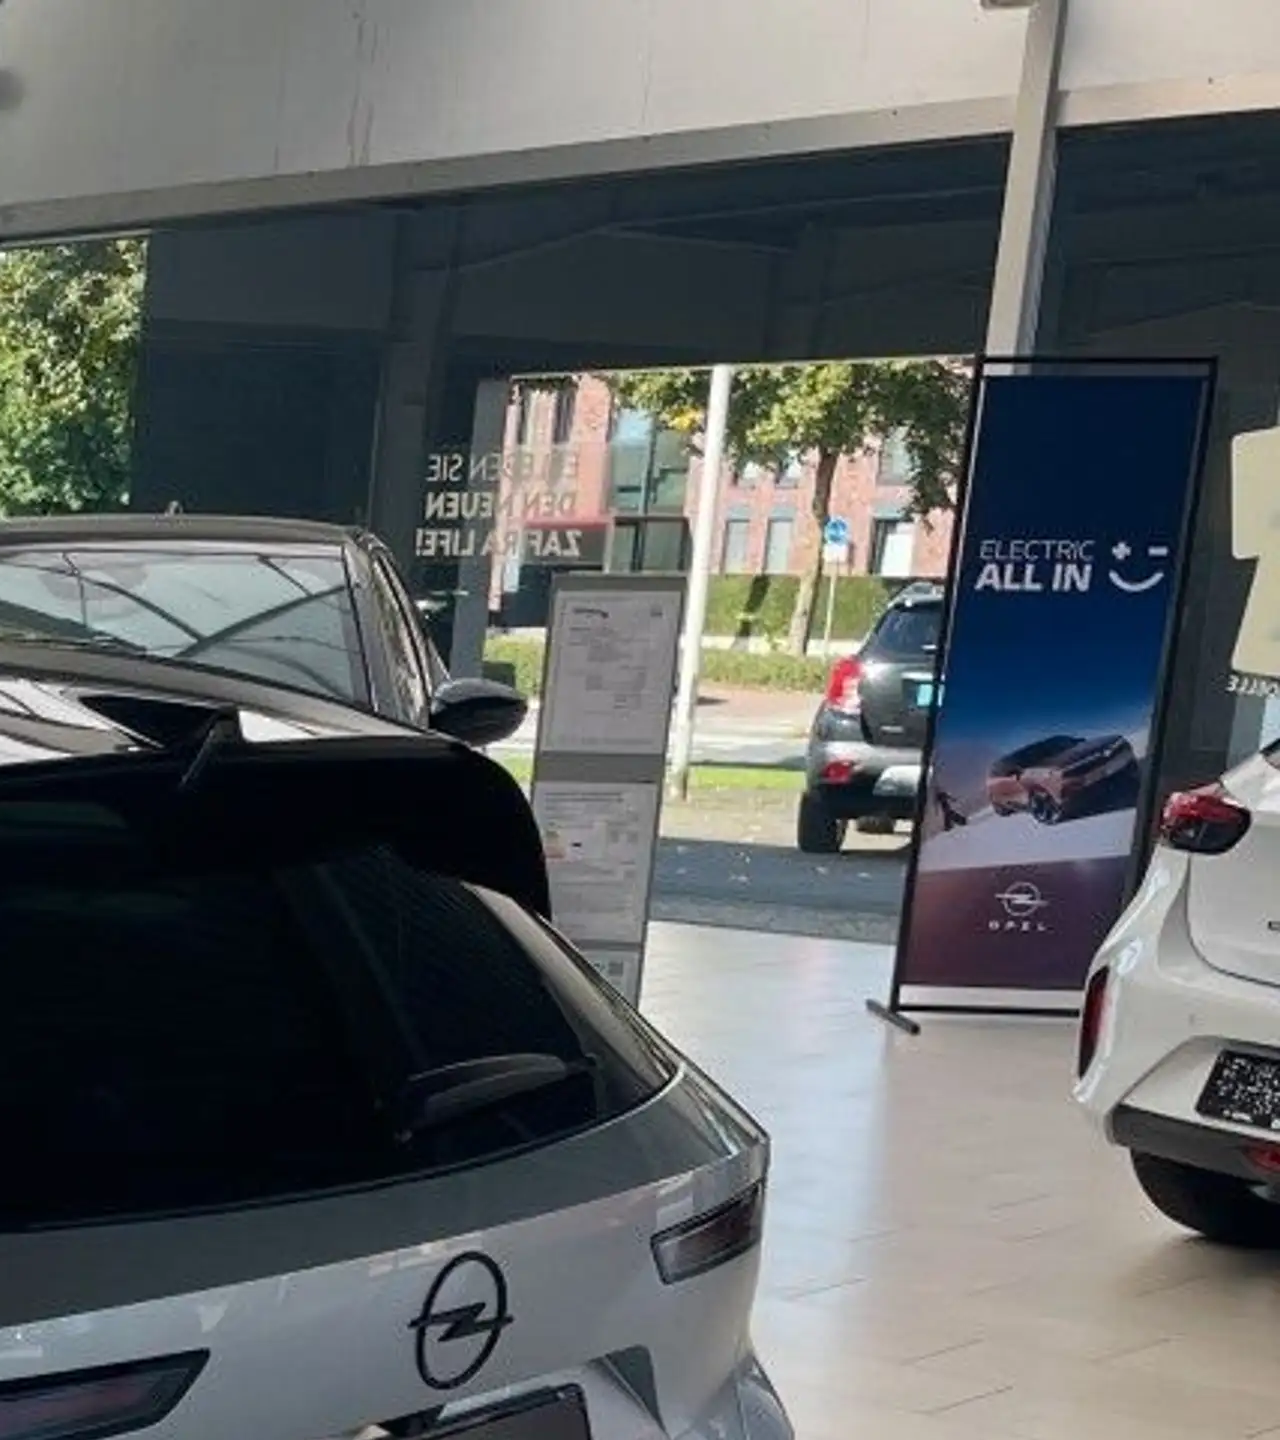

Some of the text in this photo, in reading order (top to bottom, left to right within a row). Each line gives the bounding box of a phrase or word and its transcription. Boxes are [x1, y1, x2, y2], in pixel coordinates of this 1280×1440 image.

[979, 540, 1096, 561] ELECTRIC
[974, 563, 1092, 592] ALL IN
[987, 919, 1047, 932] OPEL
